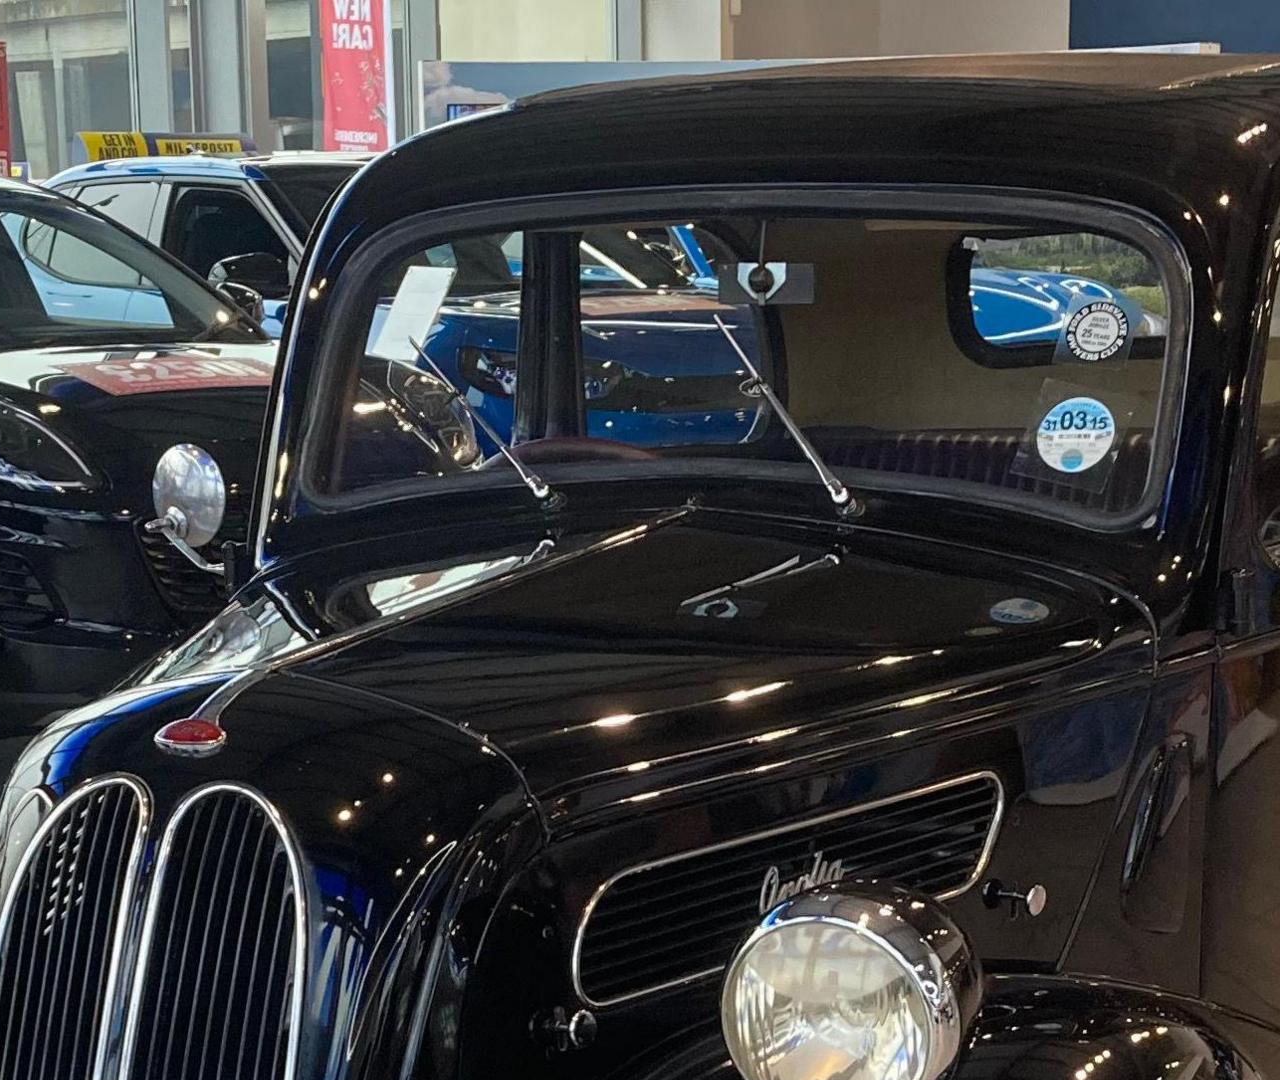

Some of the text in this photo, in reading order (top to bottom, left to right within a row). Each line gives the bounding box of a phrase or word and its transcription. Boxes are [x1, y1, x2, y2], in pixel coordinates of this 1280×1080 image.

[102, 134, 136, 146] GET IN
[98, 147, 119, 160] AND
[165, 142, 183, 154] NIL
[1081, 328, 1093, 338] 25
[1043, 410, 1109, 431] 31 03 15
